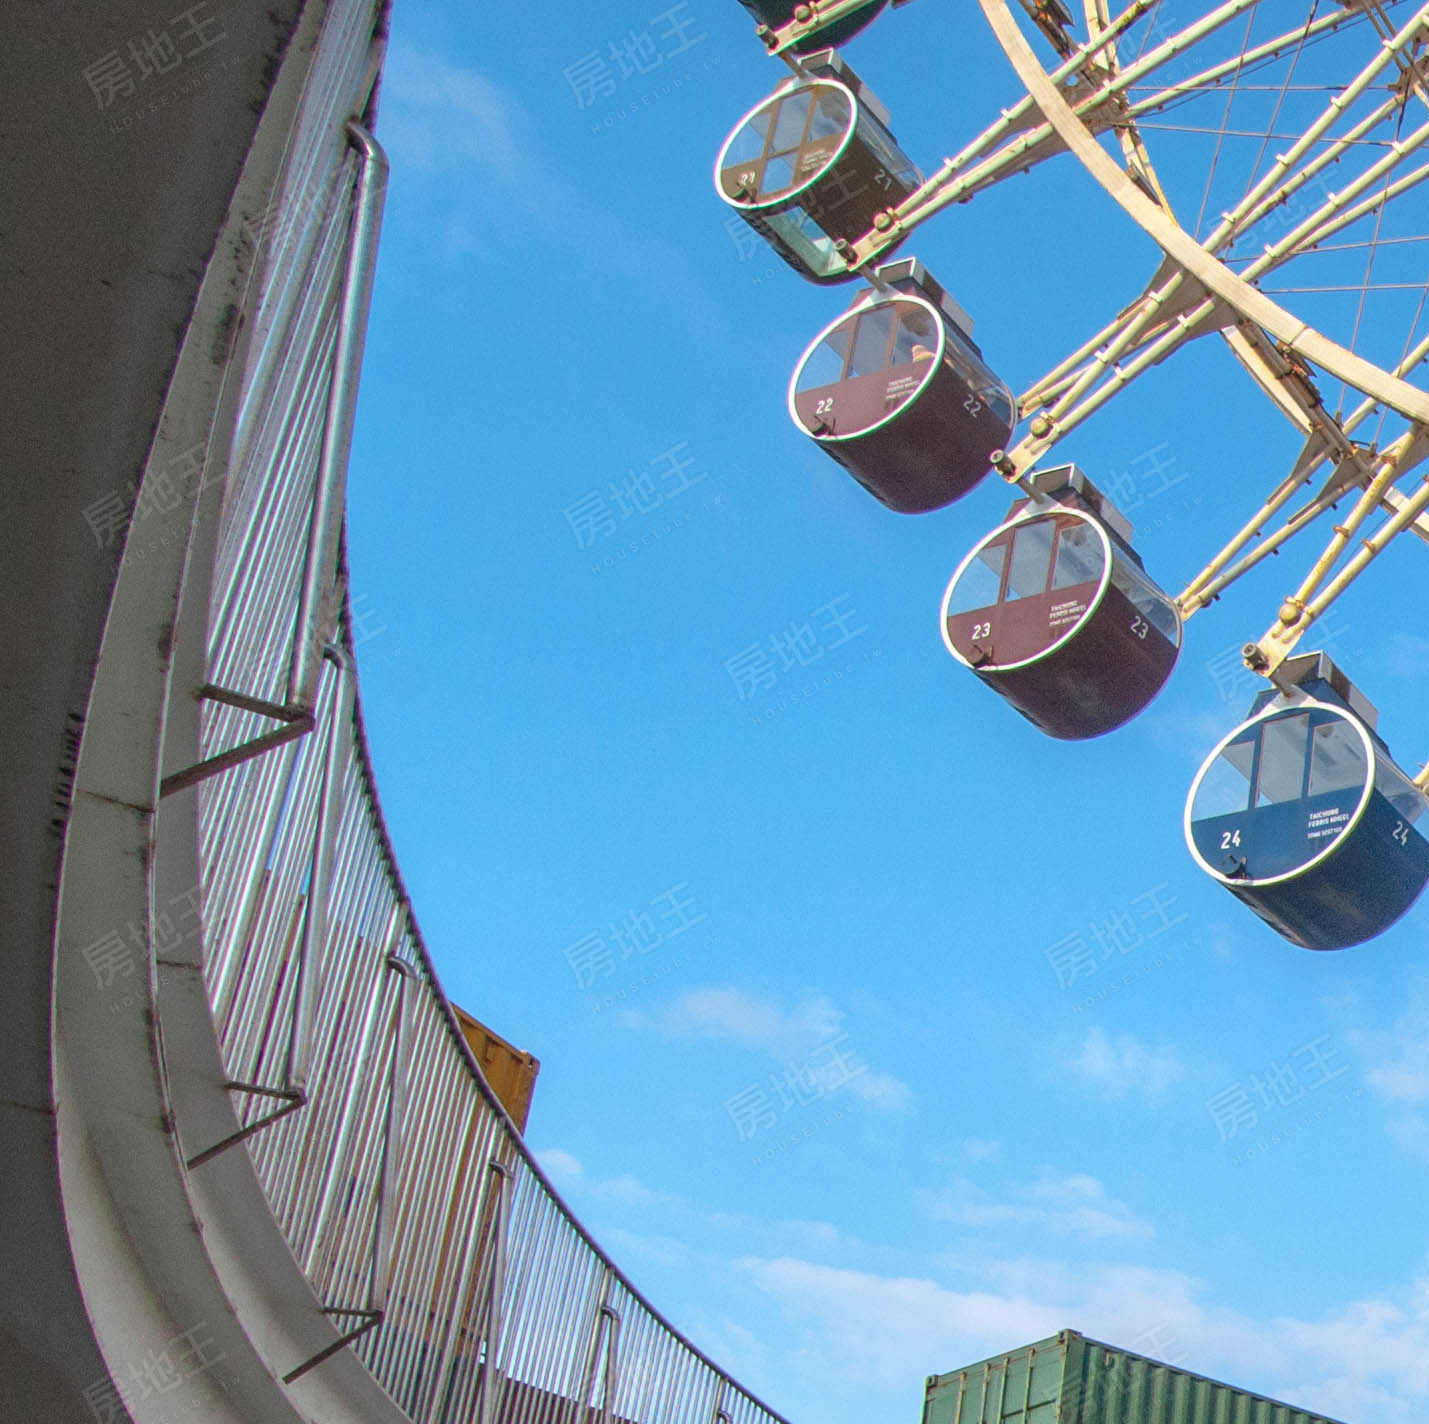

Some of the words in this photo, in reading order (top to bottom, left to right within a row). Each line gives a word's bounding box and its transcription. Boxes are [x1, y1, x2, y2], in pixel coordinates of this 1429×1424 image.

[816, 398, 833, 414] 22
[963, 394, 981, 418] 22
[972, 622, 991, 641] 23
[1130, 616, 1149, 639] 23
[1220, 829, 1241, 850] 24
[1392, 821, 1409, 847] 24
